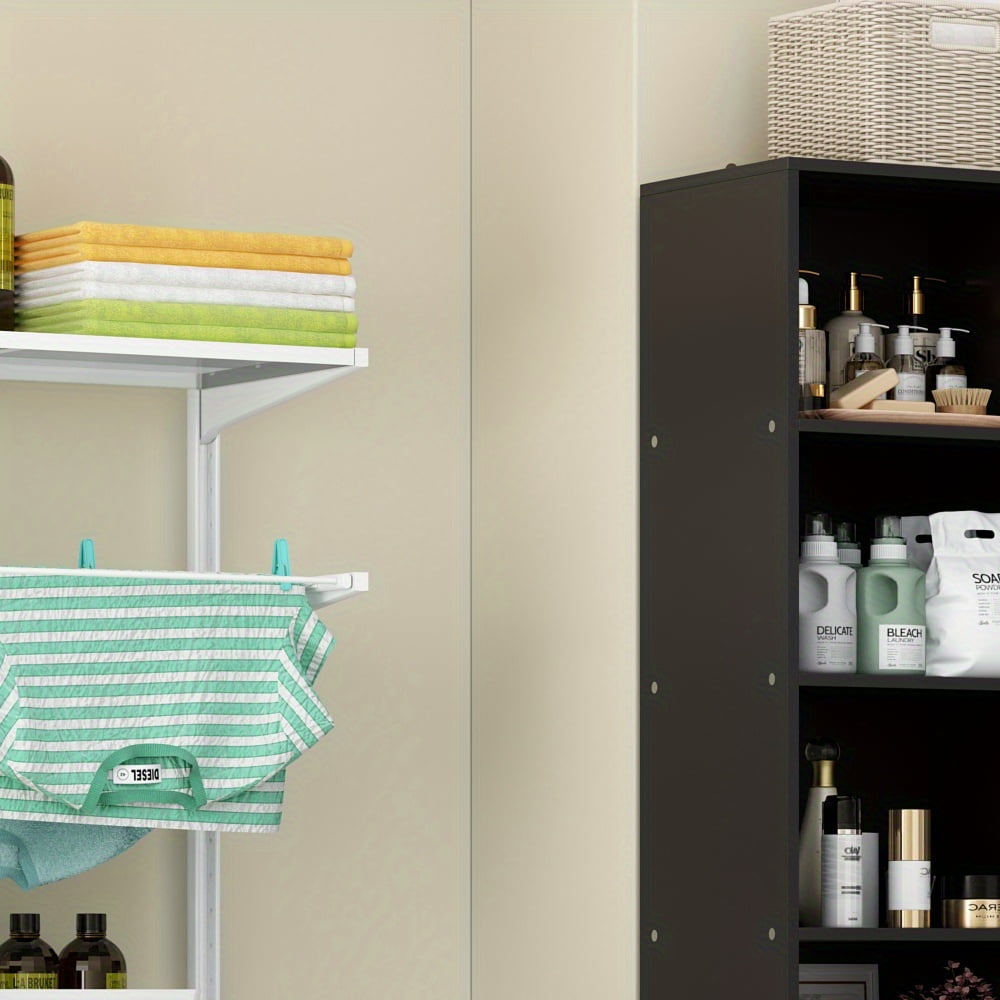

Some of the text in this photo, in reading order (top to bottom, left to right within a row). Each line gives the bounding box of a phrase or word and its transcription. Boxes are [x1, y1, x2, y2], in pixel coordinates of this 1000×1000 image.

[816, 625, 854, 636] DELICATE
[887, 628, 923, 638] BLEACH
[131, 768, 160, 781] DIESEL
